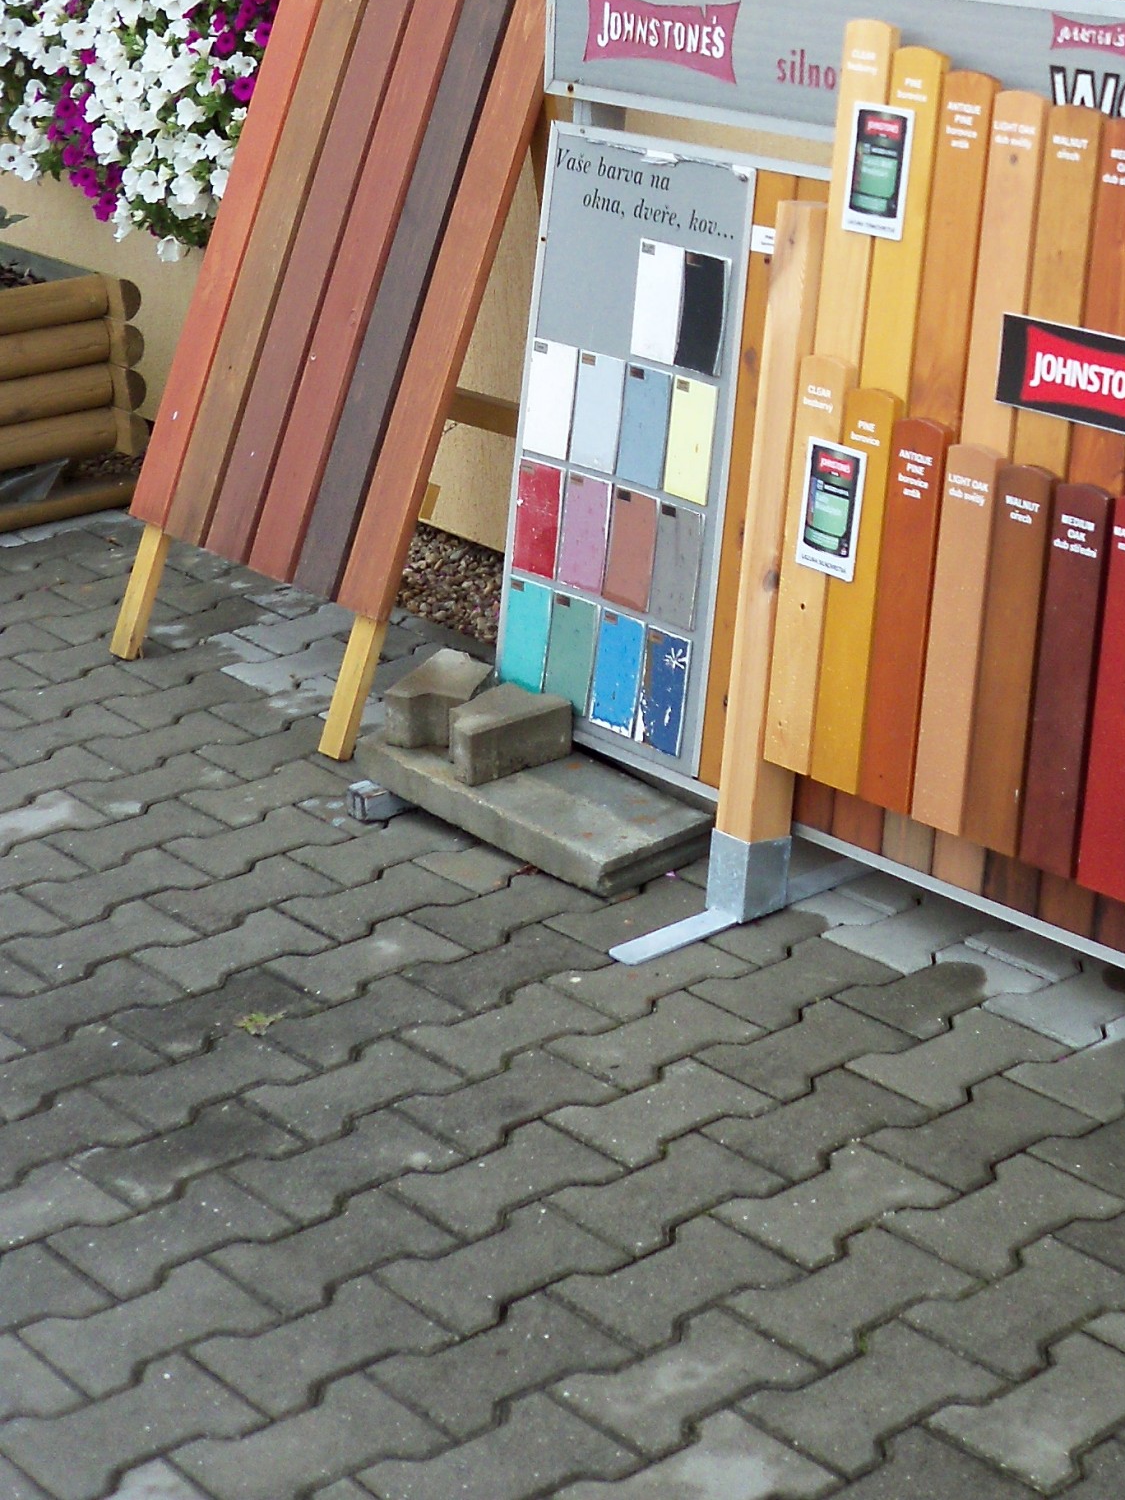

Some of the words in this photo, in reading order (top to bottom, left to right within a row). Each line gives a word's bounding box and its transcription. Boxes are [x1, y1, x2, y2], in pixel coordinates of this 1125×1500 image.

[555, 148, 591, 174] Vaše
[598, 157, 642, 185] barva
[650, 172, 670, 191] na
[583, 188, 625, 220] okna,
[633, 198, 681, 229] dveře,
[689, 209, 734, 240] kov...
[808, 384, 832, 398] CLEAR
[858, 420, 875, 433] PINE
[899, 449, 933, 466] ANTIQUE
[906, 462, 925, 476] PINE
[948, 472, 972, 489] LIGHT
[971, 478, 989, 493] OAK
[1005, 494, 1040, 513] WALNUT
[1067, 529, 1086, 542] OAK
